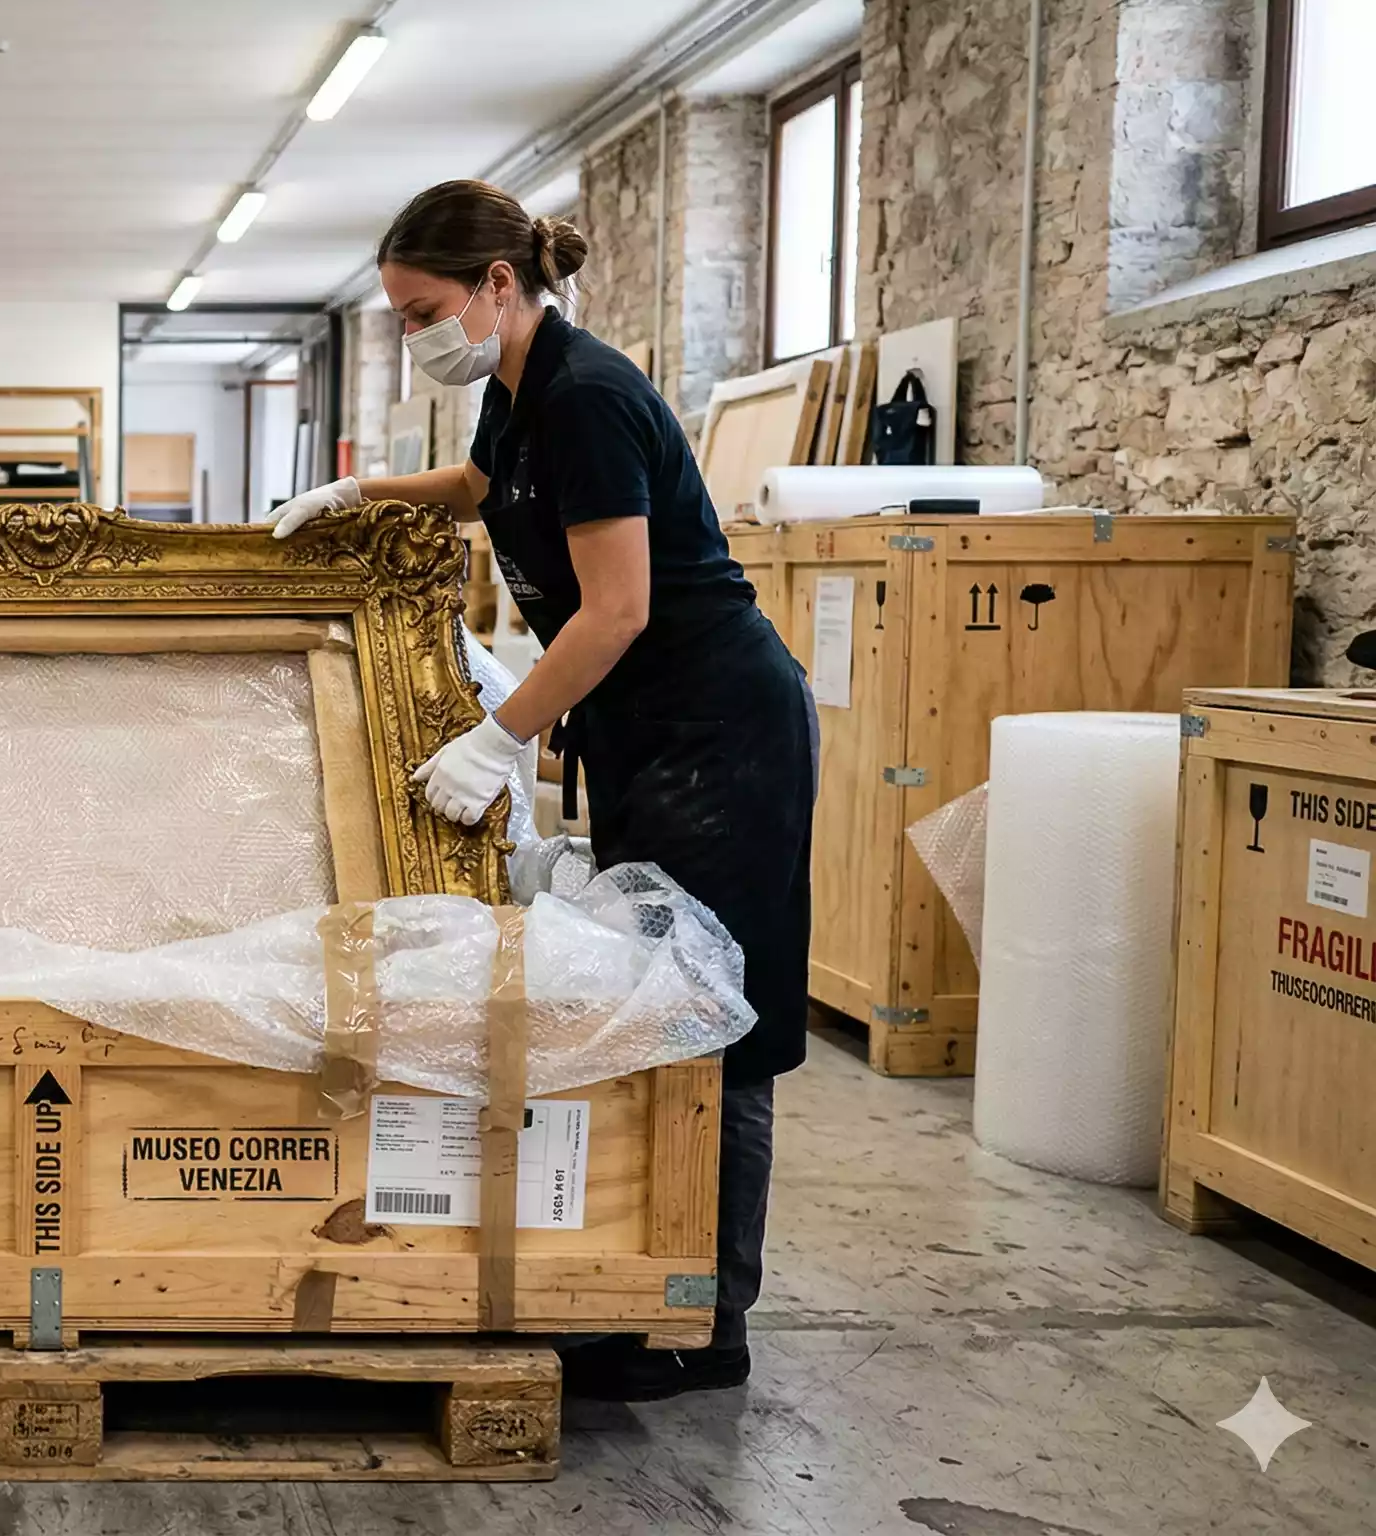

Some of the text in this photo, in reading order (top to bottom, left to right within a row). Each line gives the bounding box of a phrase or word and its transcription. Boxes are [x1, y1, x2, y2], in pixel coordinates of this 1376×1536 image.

[1290, 790, 1376, 832] THIS SIDE
[132, 1137, 330, 1161] MUSEO CORRER
[35, 1102, 61, 1255] THIS SIDE UP
[179, 1168, 283, 1191] VENEZIA
